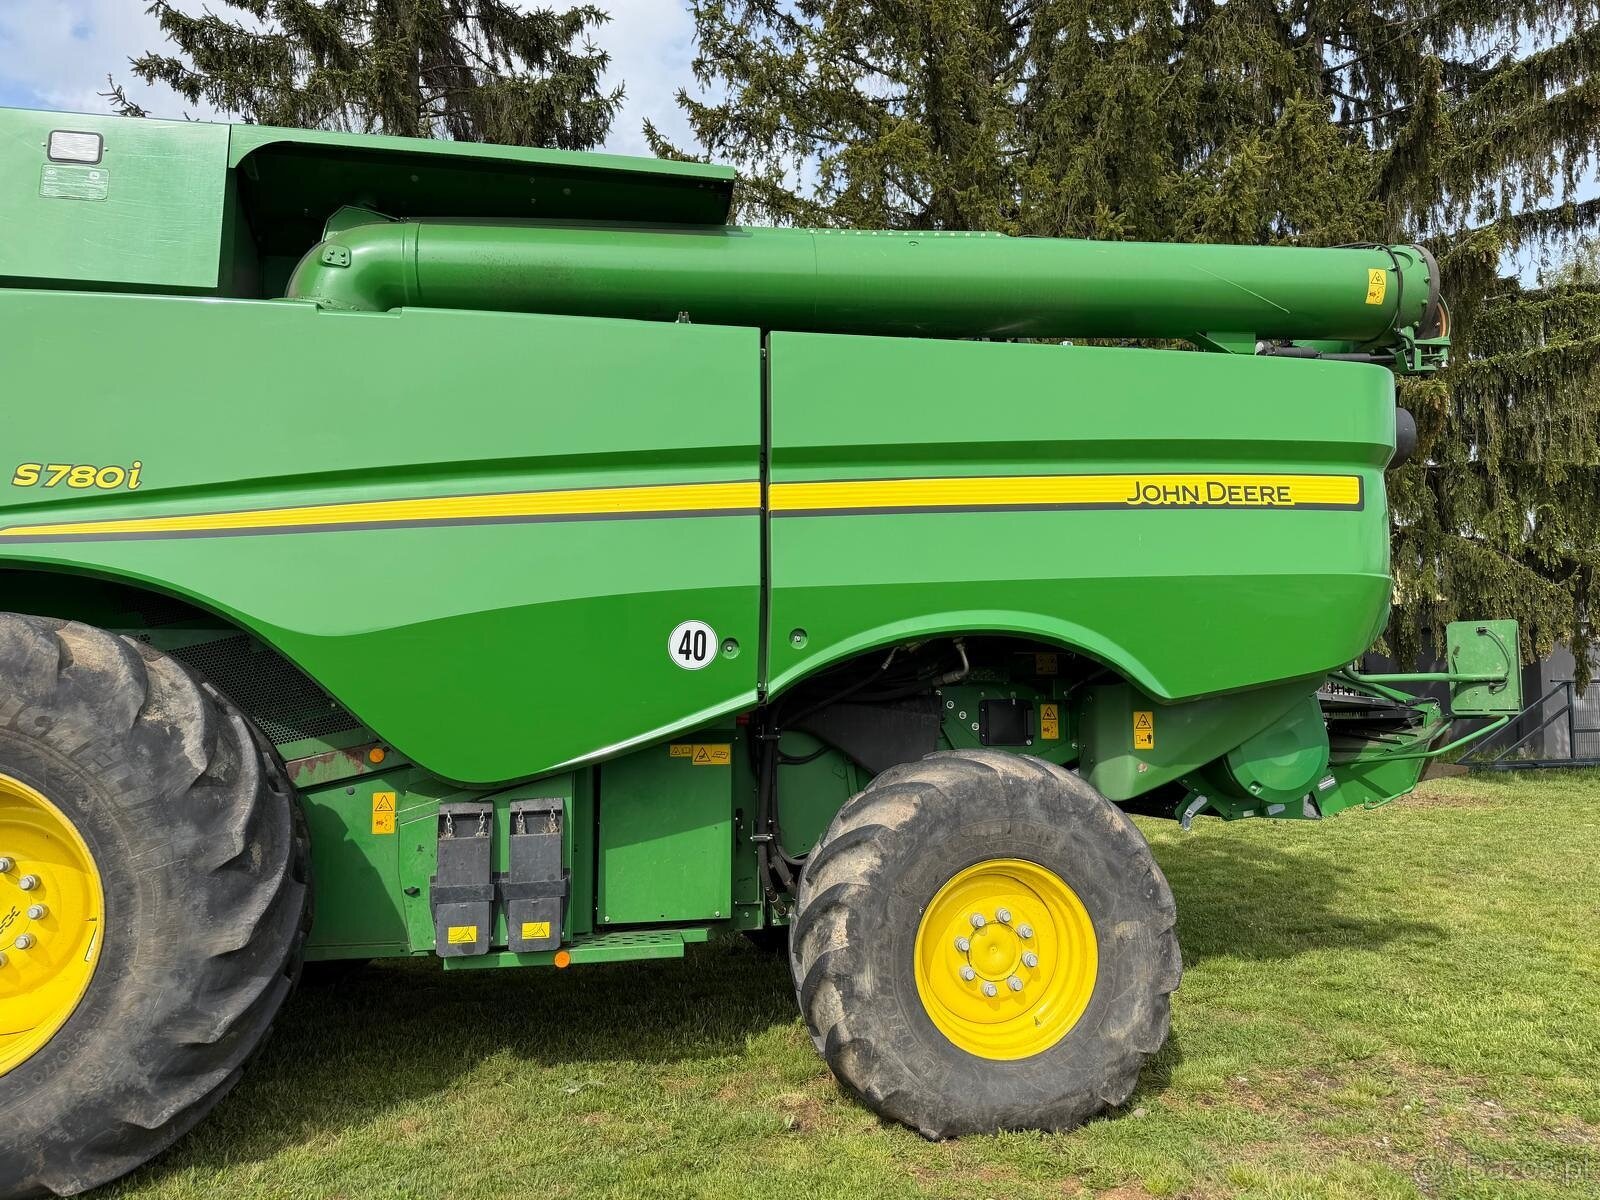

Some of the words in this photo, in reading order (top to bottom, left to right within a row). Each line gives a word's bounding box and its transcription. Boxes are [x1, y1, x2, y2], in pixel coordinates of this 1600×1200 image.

[1127, 481, 1199, 502] JOHN
[1206, 481, 1292, 503] DEERE
[678, 629, 707, 661] 40
